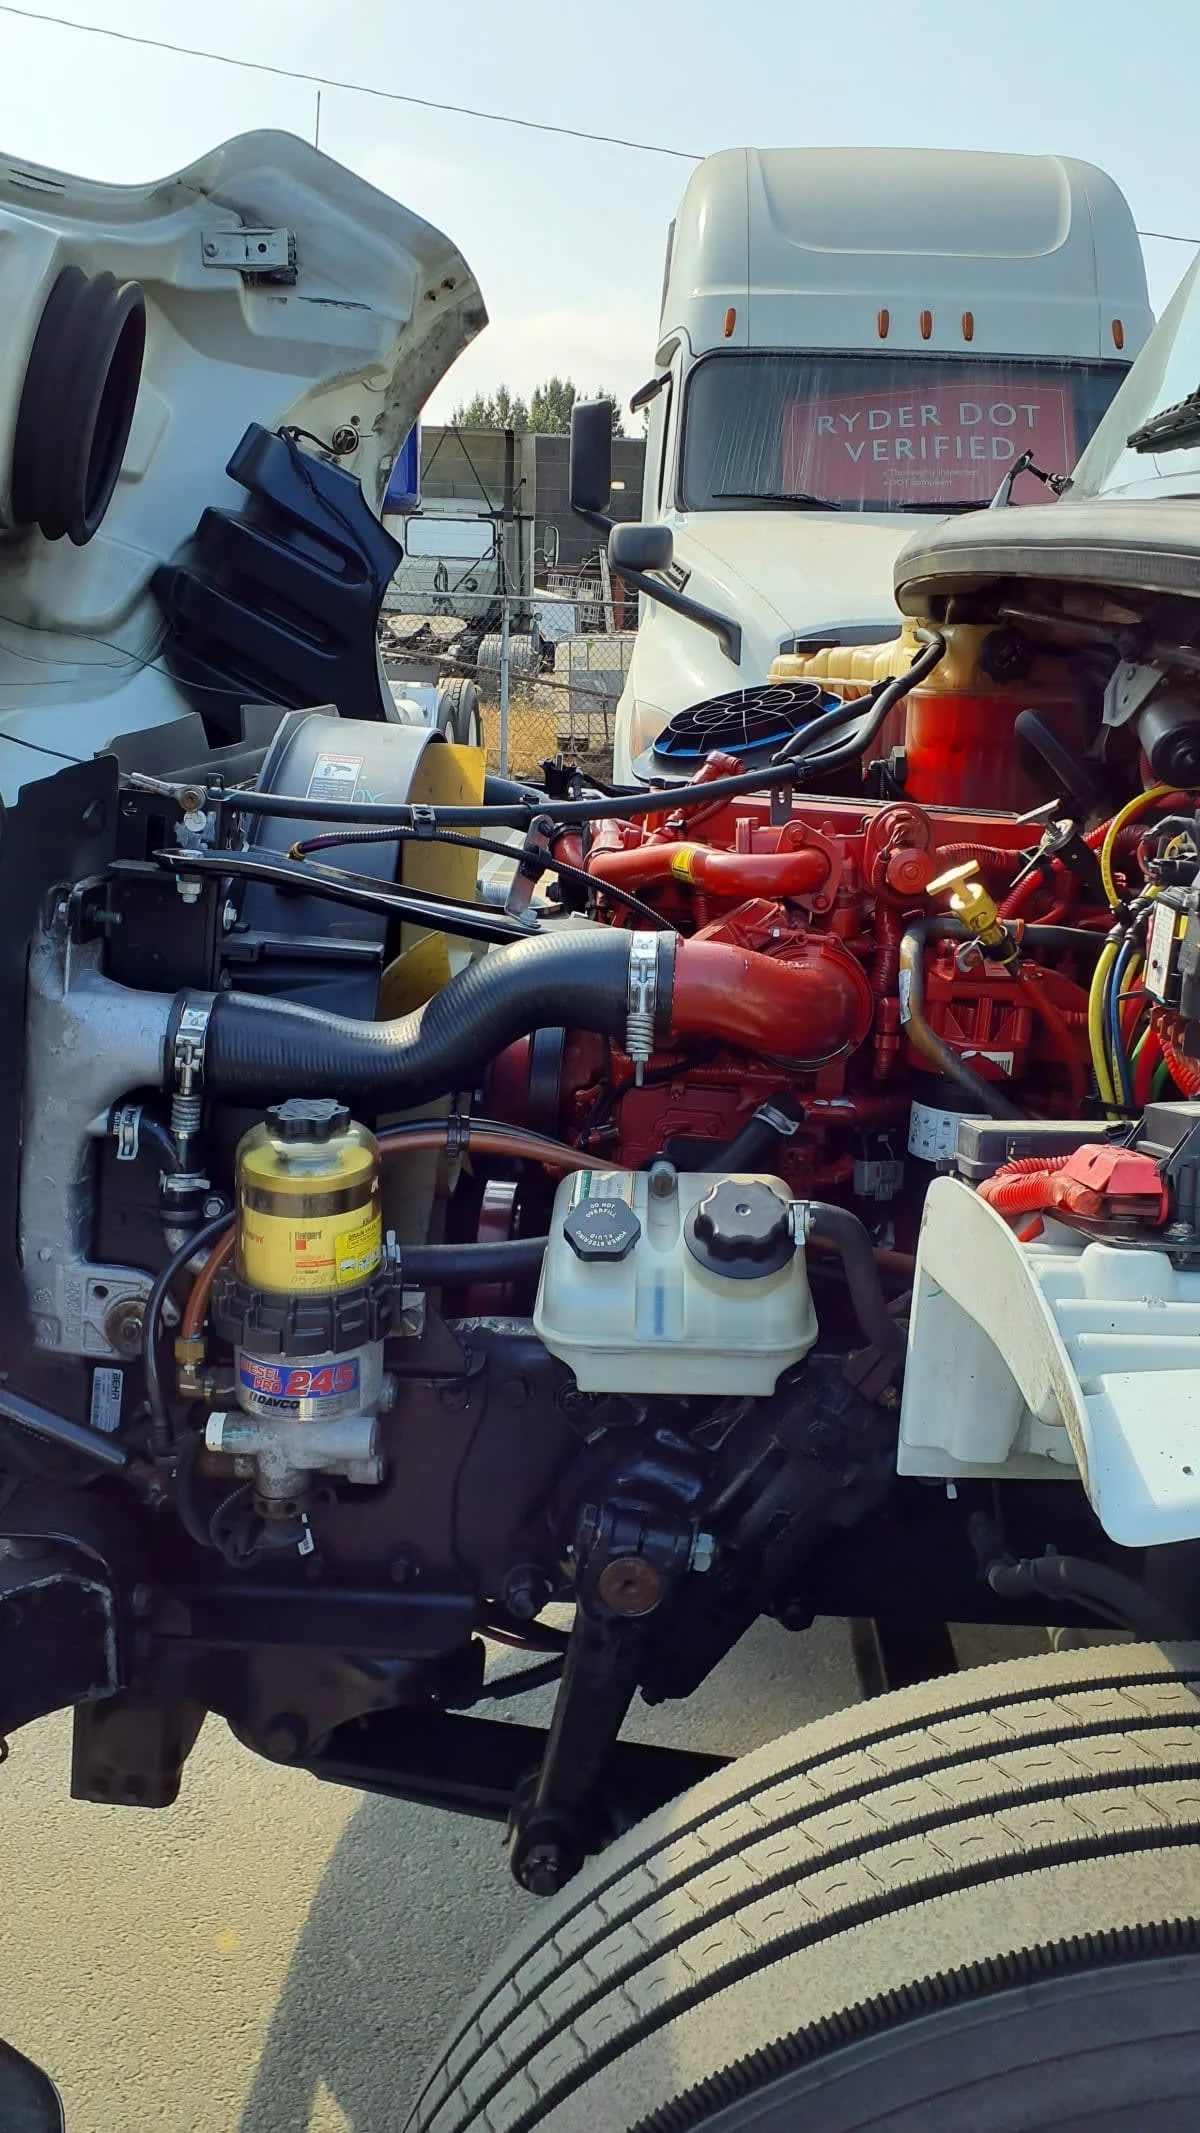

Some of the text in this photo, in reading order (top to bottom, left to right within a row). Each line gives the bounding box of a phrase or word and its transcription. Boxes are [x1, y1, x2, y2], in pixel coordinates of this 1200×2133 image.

[816, 402, 1041, 435] RYDER DOT
[844, 436, 1015, 463] VERIFIED
[585, 1208, 617, 1218] OVERFILL
[241, 1358, 280, 1380] DIESEL
[286, 1363, 354, 1397] 245
[253, 1376, 282, 1393] PRO
[257, 1394, 301, 1409] DAYCO
